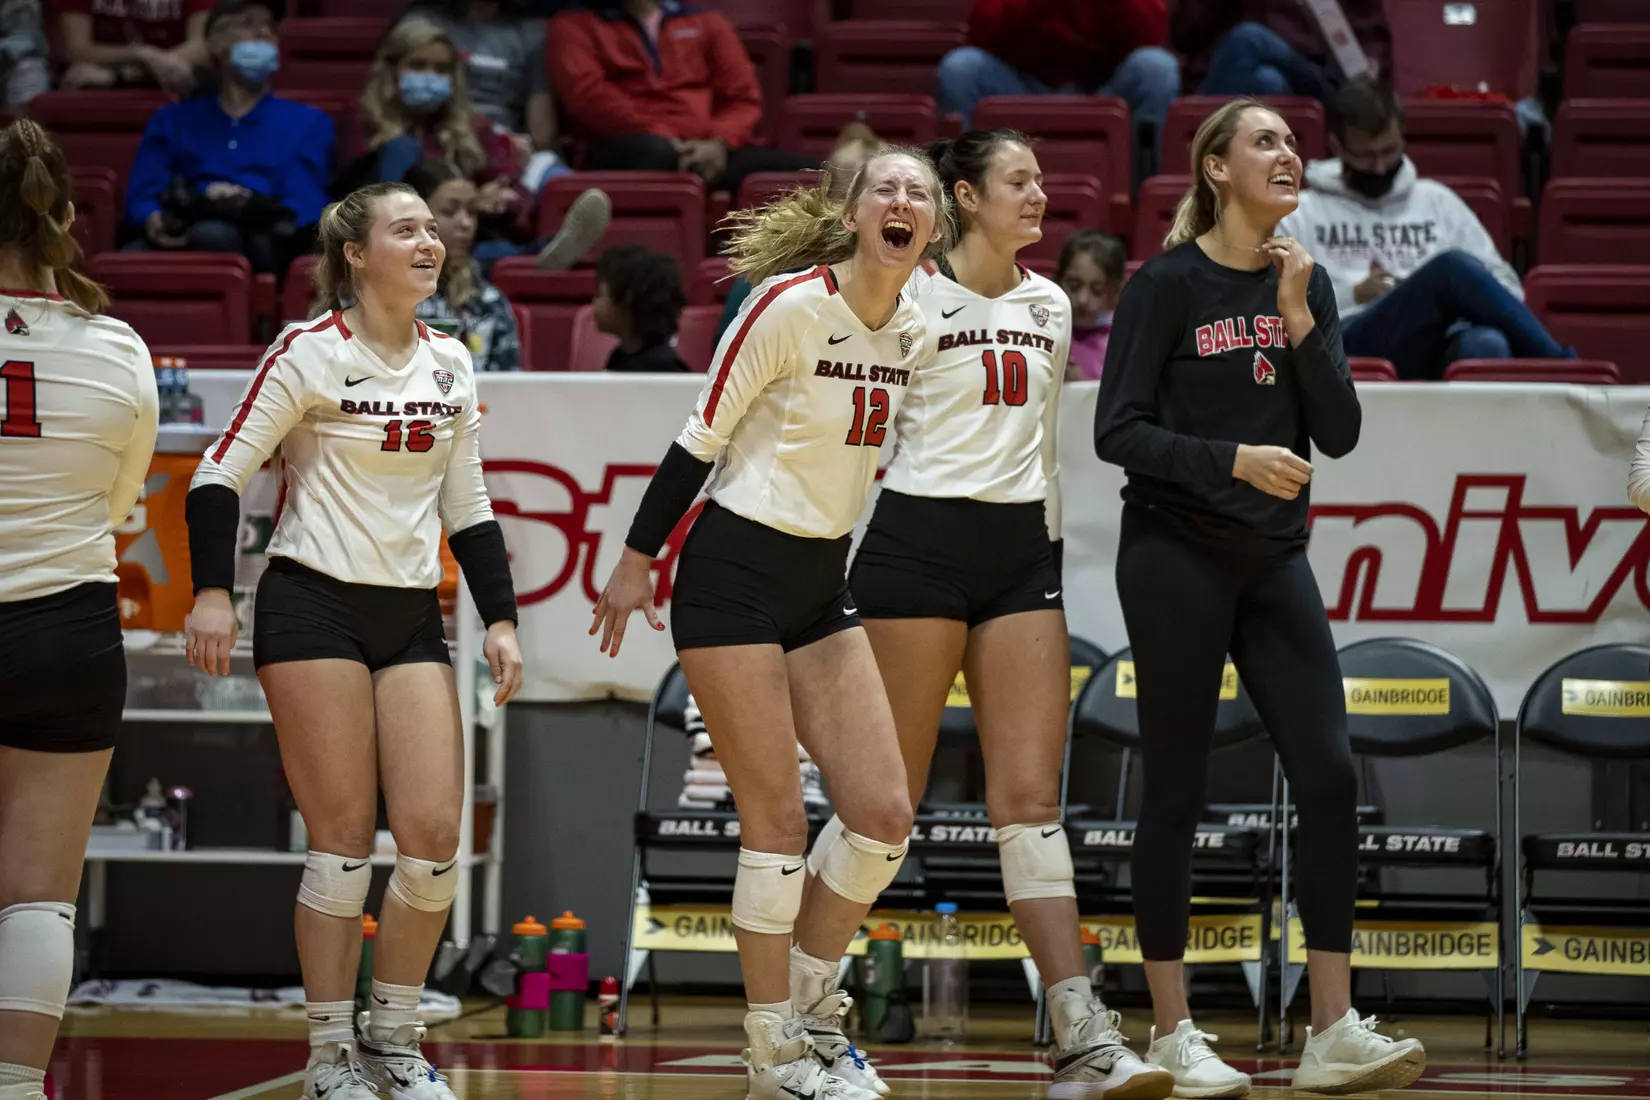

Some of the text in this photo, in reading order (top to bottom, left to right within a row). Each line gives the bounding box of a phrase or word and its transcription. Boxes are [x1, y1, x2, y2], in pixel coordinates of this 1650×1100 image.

[1373, 219, 1437, 248] STATE
[937, 329, 1054, 353] BALL STATE
[1196, 316, 1253, 357] BALL
[814, 359, 910, 387] BALL STATE
[982, 349, 1028, 406] 10
[340, 398, 462, 417] BALL STATE
[845, 386, 890, 447] 12
[1306, 473, 1650, 624] niv
[1350, 687, 1448, 705] GAINBRIDGE
[1585, 688, 1650, 708] GAINBRI
[658, 820, 719, 836] BALL
[1385, 834, 1462, 852] STATE
[1556, 842, 1618, 858] BALL
[674, 914, 733, 939] GAIN
[1352, 931, 1492, 957] AINBRIDGE
[1564, 937, 1650, 964] GAINB
